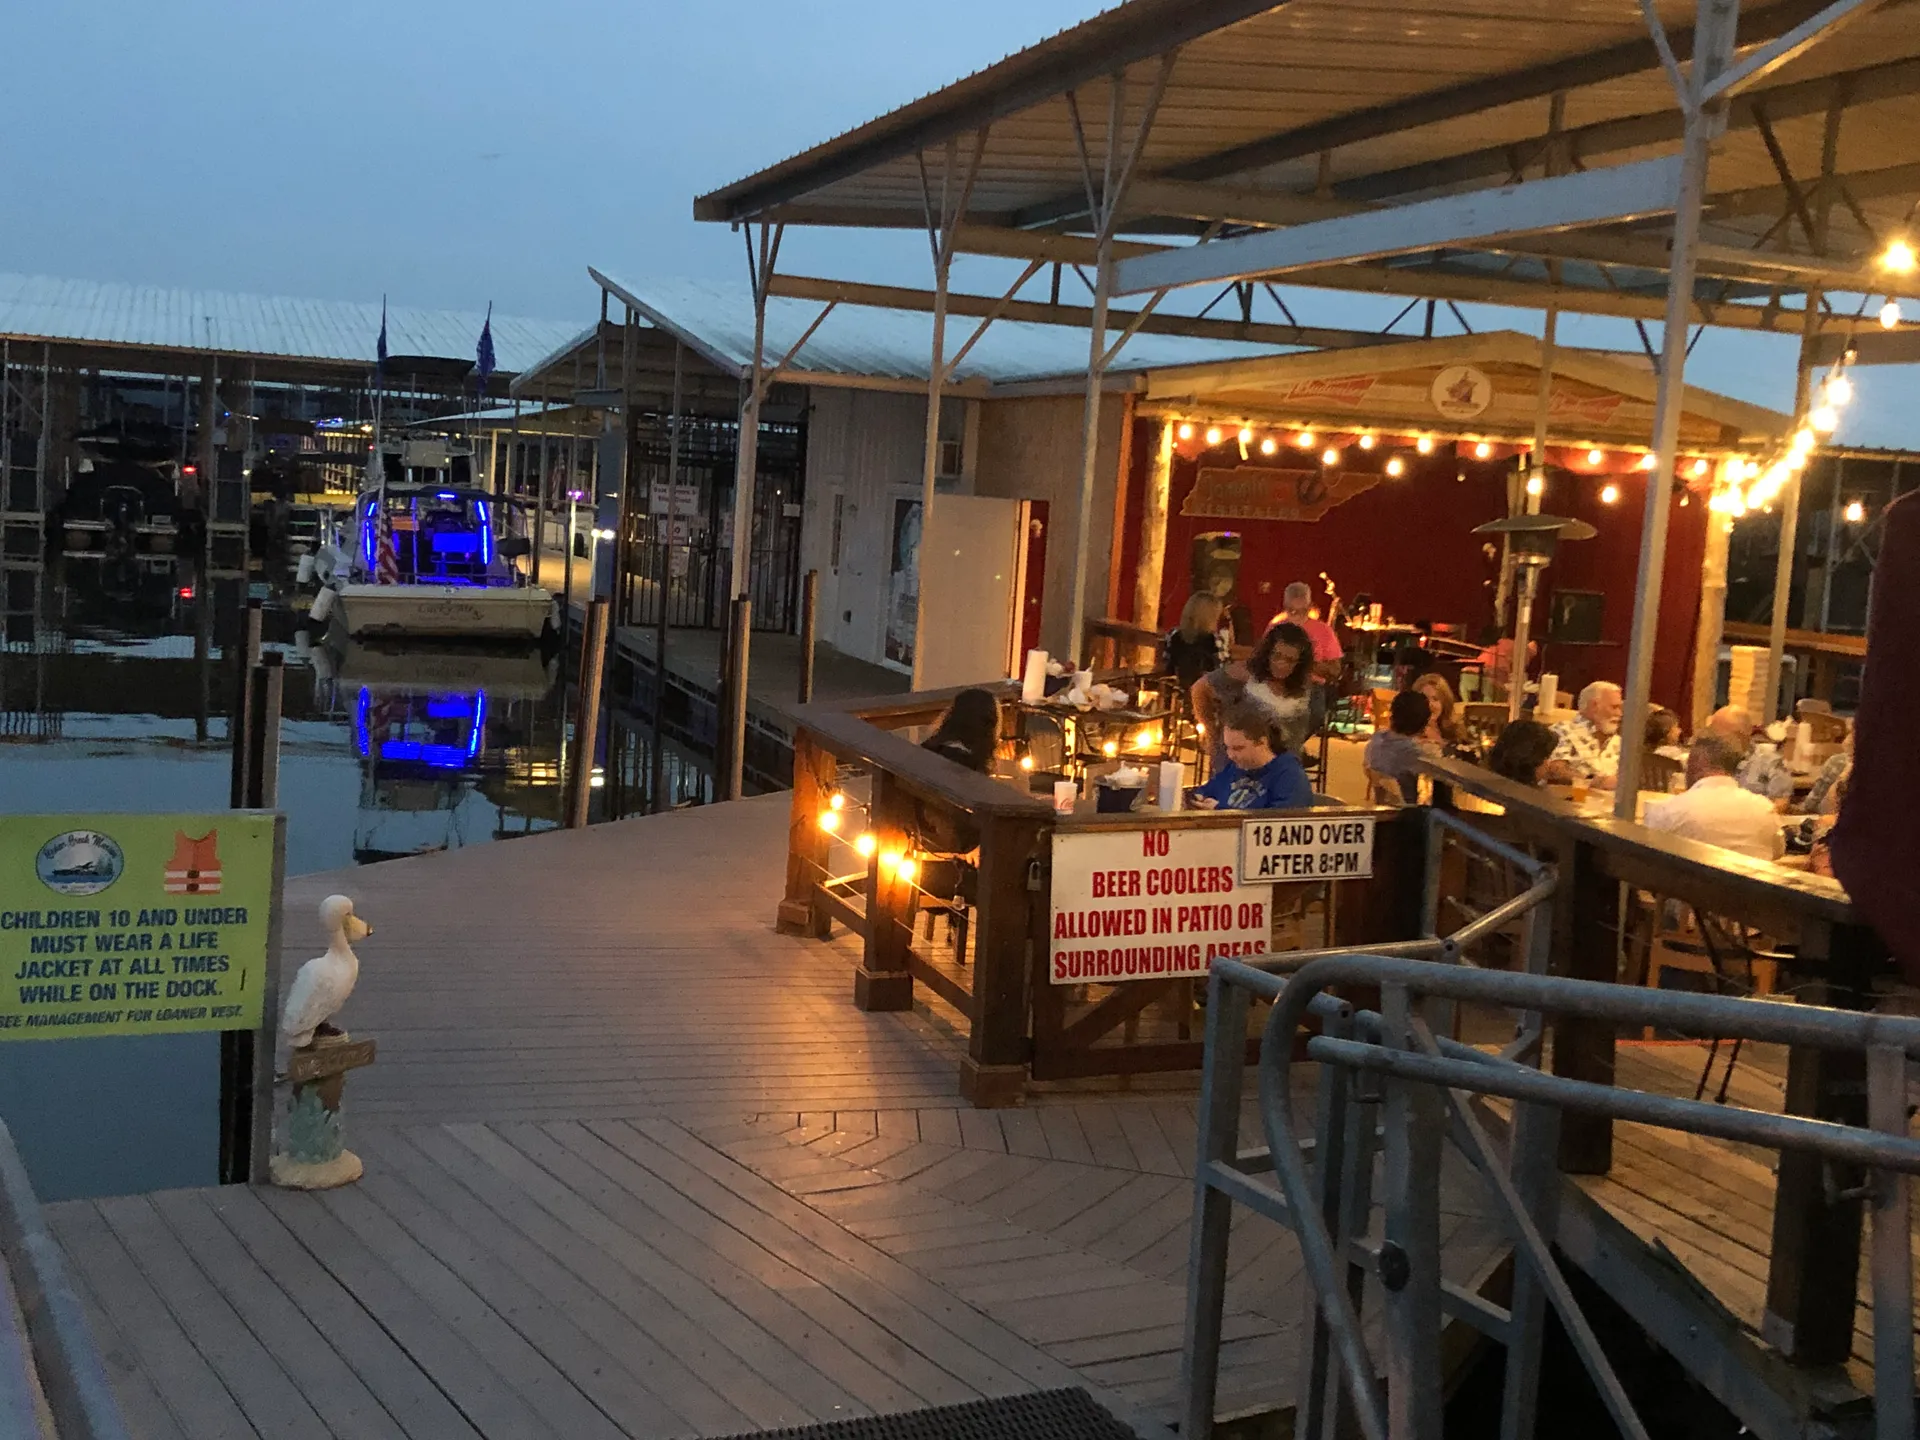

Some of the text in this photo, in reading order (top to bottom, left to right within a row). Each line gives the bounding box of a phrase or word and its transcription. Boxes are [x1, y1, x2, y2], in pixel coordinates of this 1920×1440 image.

[1142, 829, 1169, 857] NO
[1253, 823, 1366, 847] 18 AND OVER
[1258, 852, 1360, 876] AFTER 8:PM
[1092, 866, 1233, 898] BEER COOLERS
[1, 907, 248, 930] CHILDREN 10 AND UNDER
[1054, 902, 1264, 939] ALLOWED IN PATIO OR
[30, 931, 218, 954] MUST WEAR A LIFE
[14, 955, 230, 979] JACKET AT ALL TIMES
[1054, 944, 1200, 979] SURROUNDING
[19, 979, 223, 1004] WHILE ON THE DOCK.
[26, 1010, 124, 1027] MANAGEMENT
[126, 1009, 152, 1021] FOR
